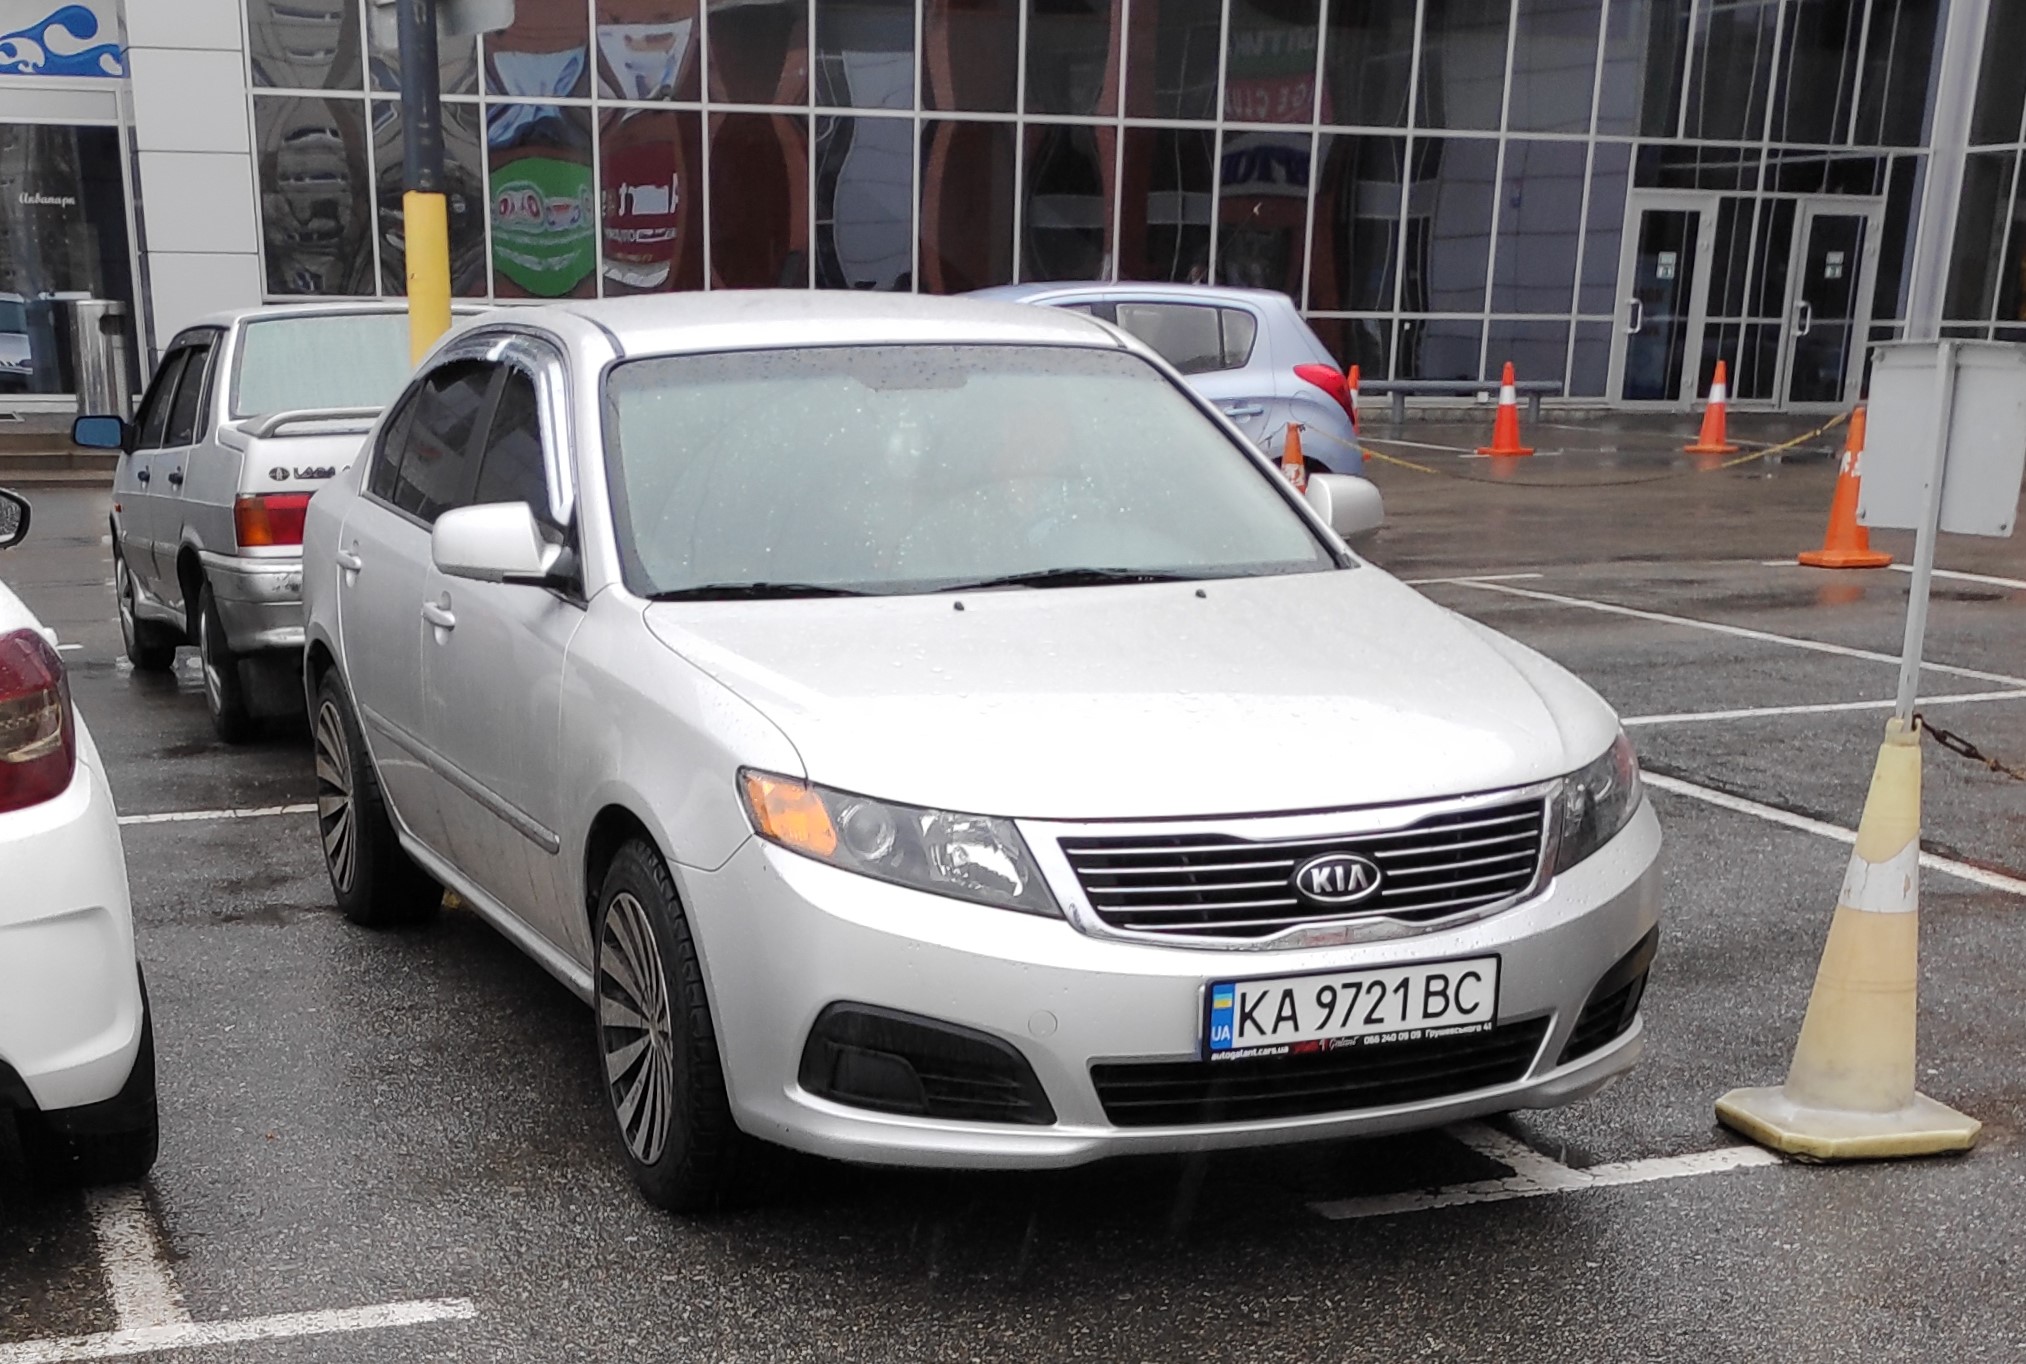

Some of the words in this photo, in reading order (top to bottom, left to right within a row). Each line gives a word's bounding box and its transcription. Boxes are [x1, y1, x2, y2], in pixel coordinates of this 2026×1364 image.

[293, 466, 336, 480] LADA
[1310, 864, 1368, 893] KIA
[1238, 988, 1300, 1038] KA
[1315, 977, 1410, 1031] 9721
[1422, 971, 1482, 1019] BC
[1212, 1025, 1231, 1042] UA
[1381, 1032, 1397, 1043] 240
